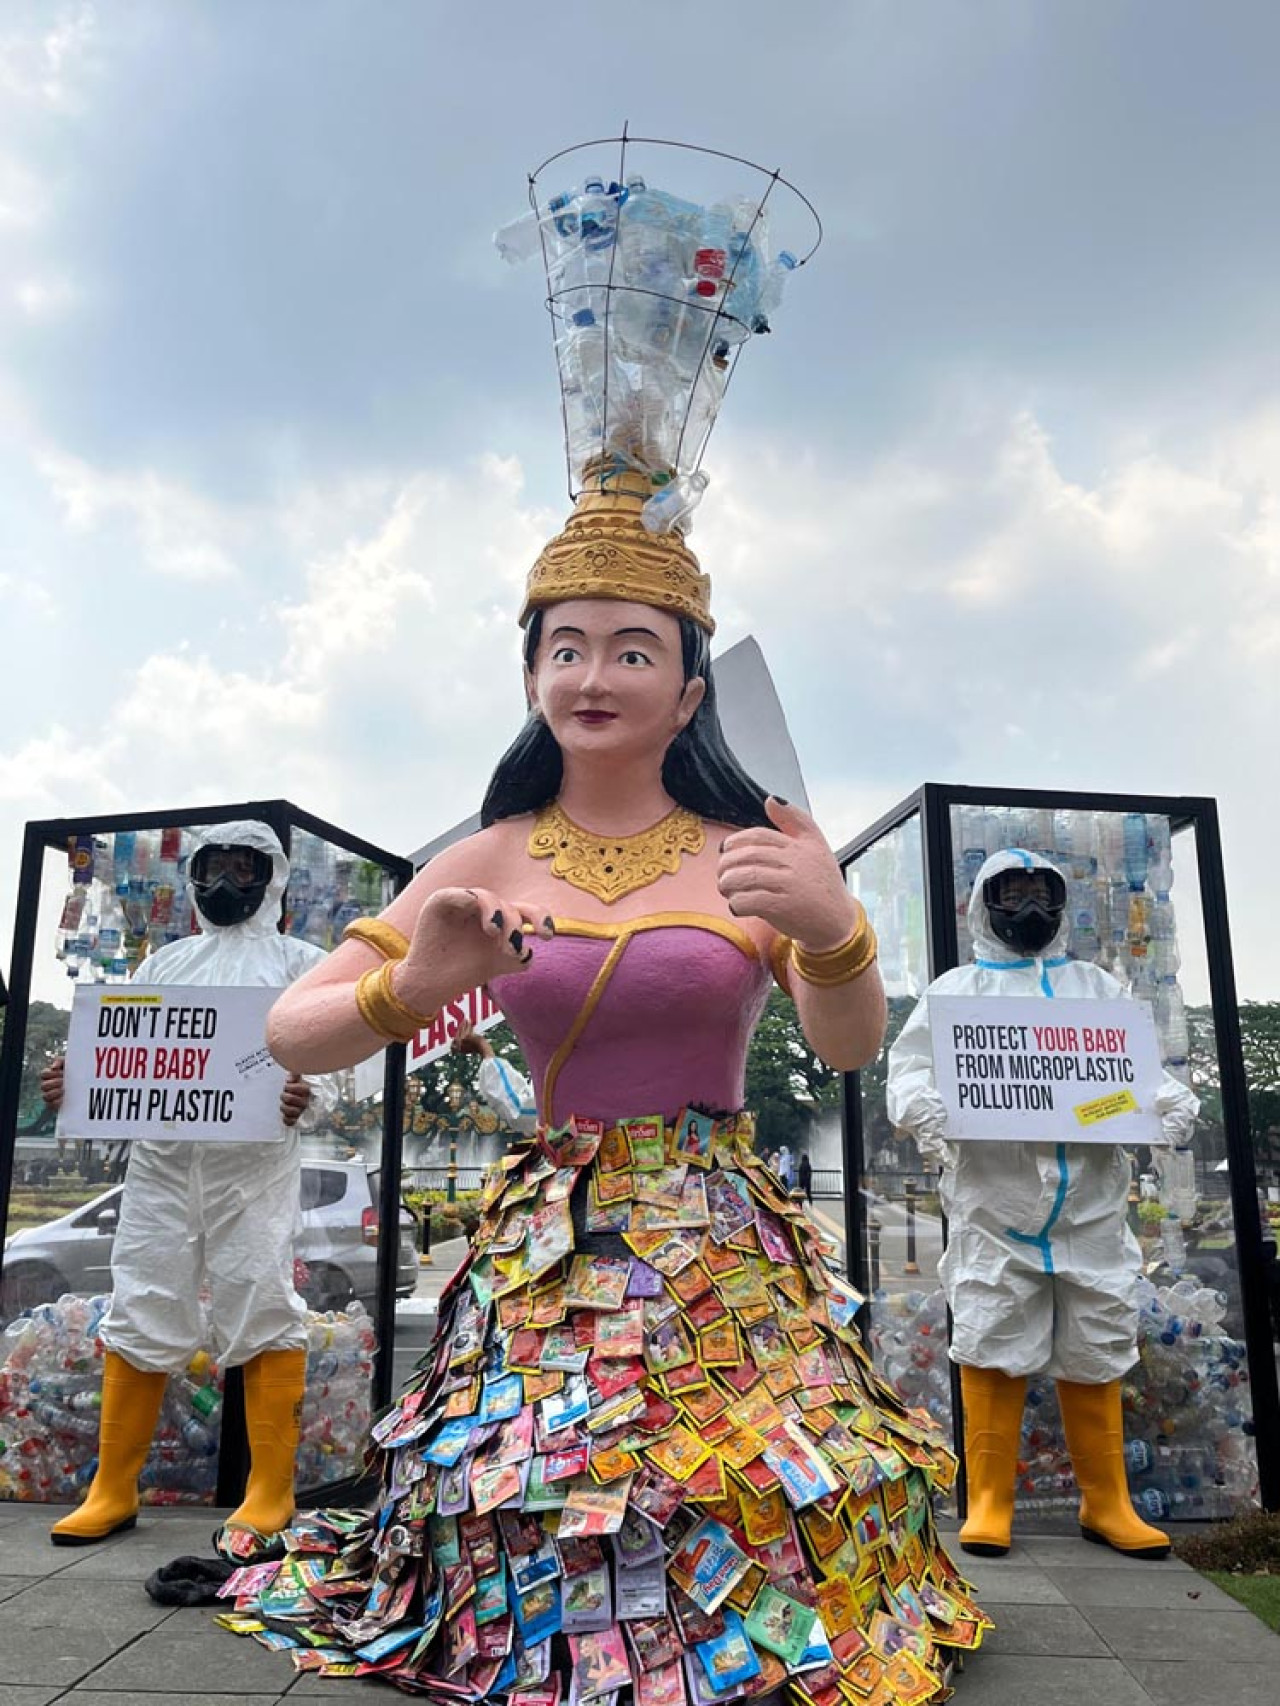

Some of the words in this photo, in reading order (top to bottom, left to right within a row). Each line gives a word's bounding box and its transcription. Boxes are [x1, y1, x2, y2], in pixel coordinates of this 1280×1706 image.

[97, 1006, 161, 1038] DON'T
[165, 1007, 217, 1040] FEED
[952, 1025, 1028, 1050] PROTECT
[1032, 1026, 1080, 1052] YOUR
[1082, 1028, 1127, 1054] BABY
[94, 1046, 148, 1079] YOUR
[153, 1047, 211, 1080] BABY
[955, 1053, 1005, 1079] FROM
[1008, 1055, 1134, 1083] MICROPLASTIC
[88, 1088, 142, 1121] WITH
[146, 1089, 235, 1123] PLASTIC
[958, 1083, 1054, 1110] POLLUTION
